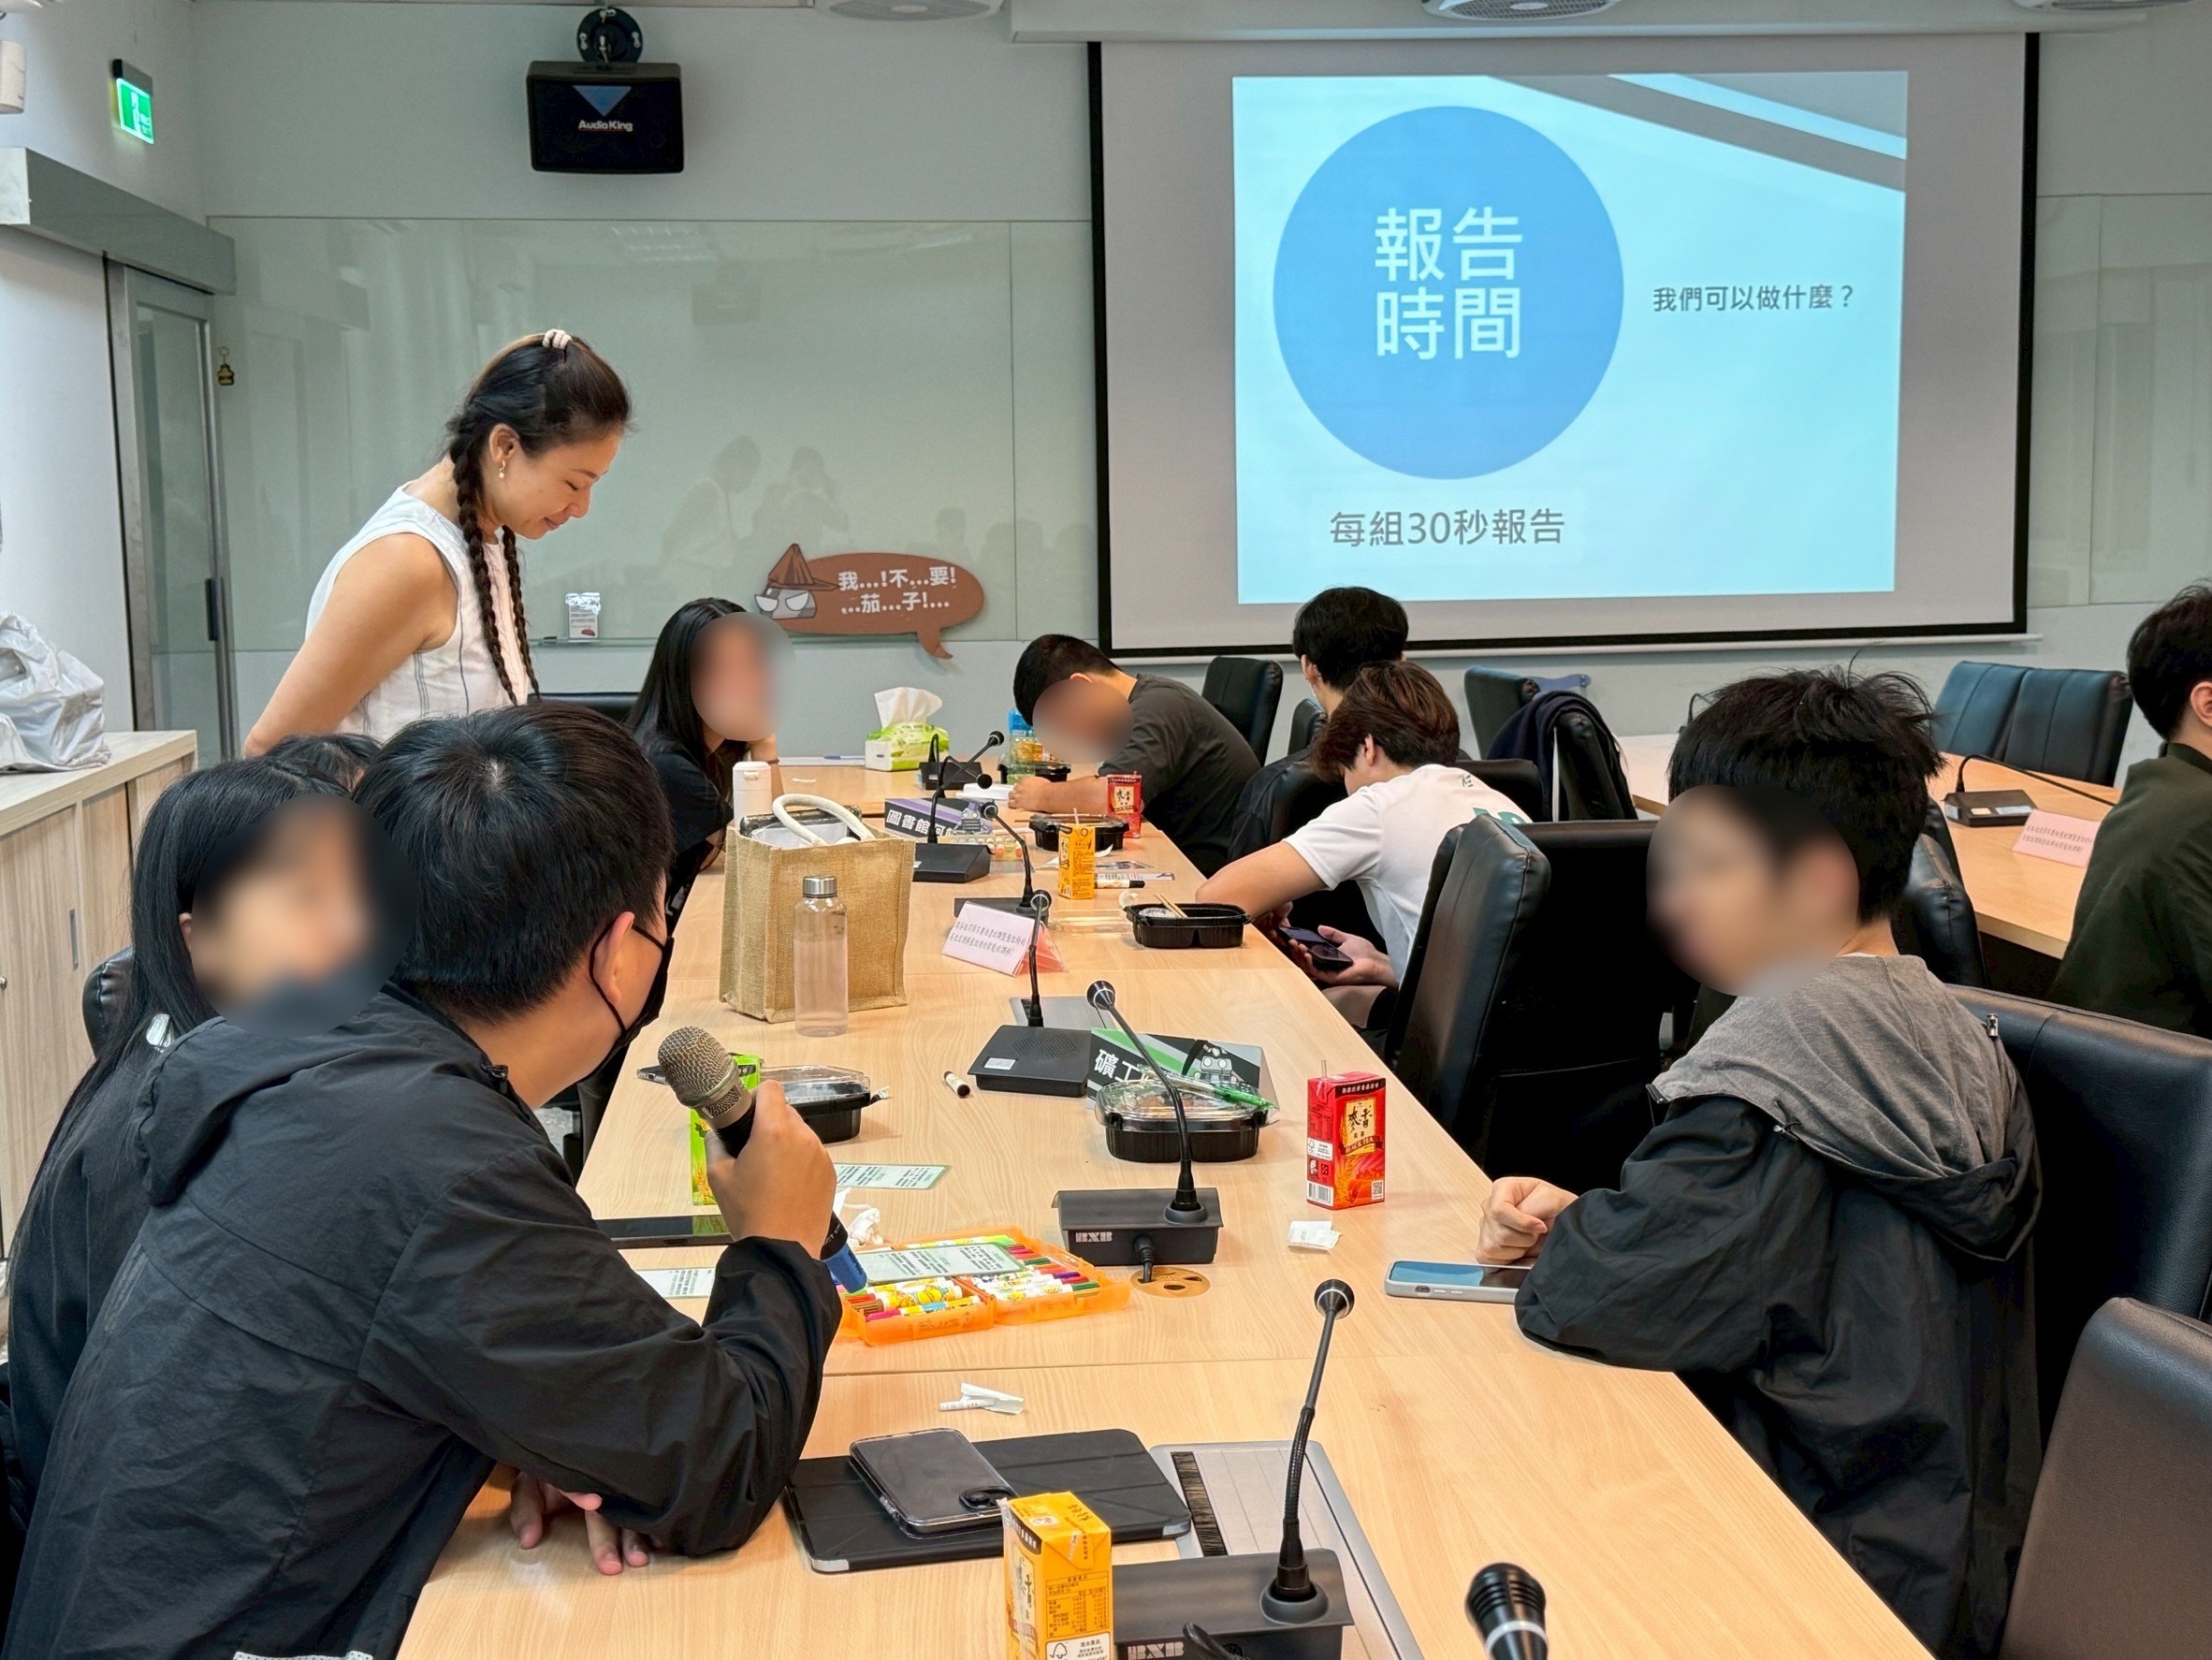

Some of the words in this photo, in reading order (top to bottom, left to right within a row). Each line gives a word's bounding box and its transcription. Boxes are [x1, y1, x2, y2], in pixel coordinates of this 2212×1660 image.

[1375, 207, 1523, 282] 報告
[1375, 286, 1522, 360] 時間
[1652, 284, 1855, 313] 我們可以做什麼？
[1329, 507, 1566, 548] 每組30秒報告
